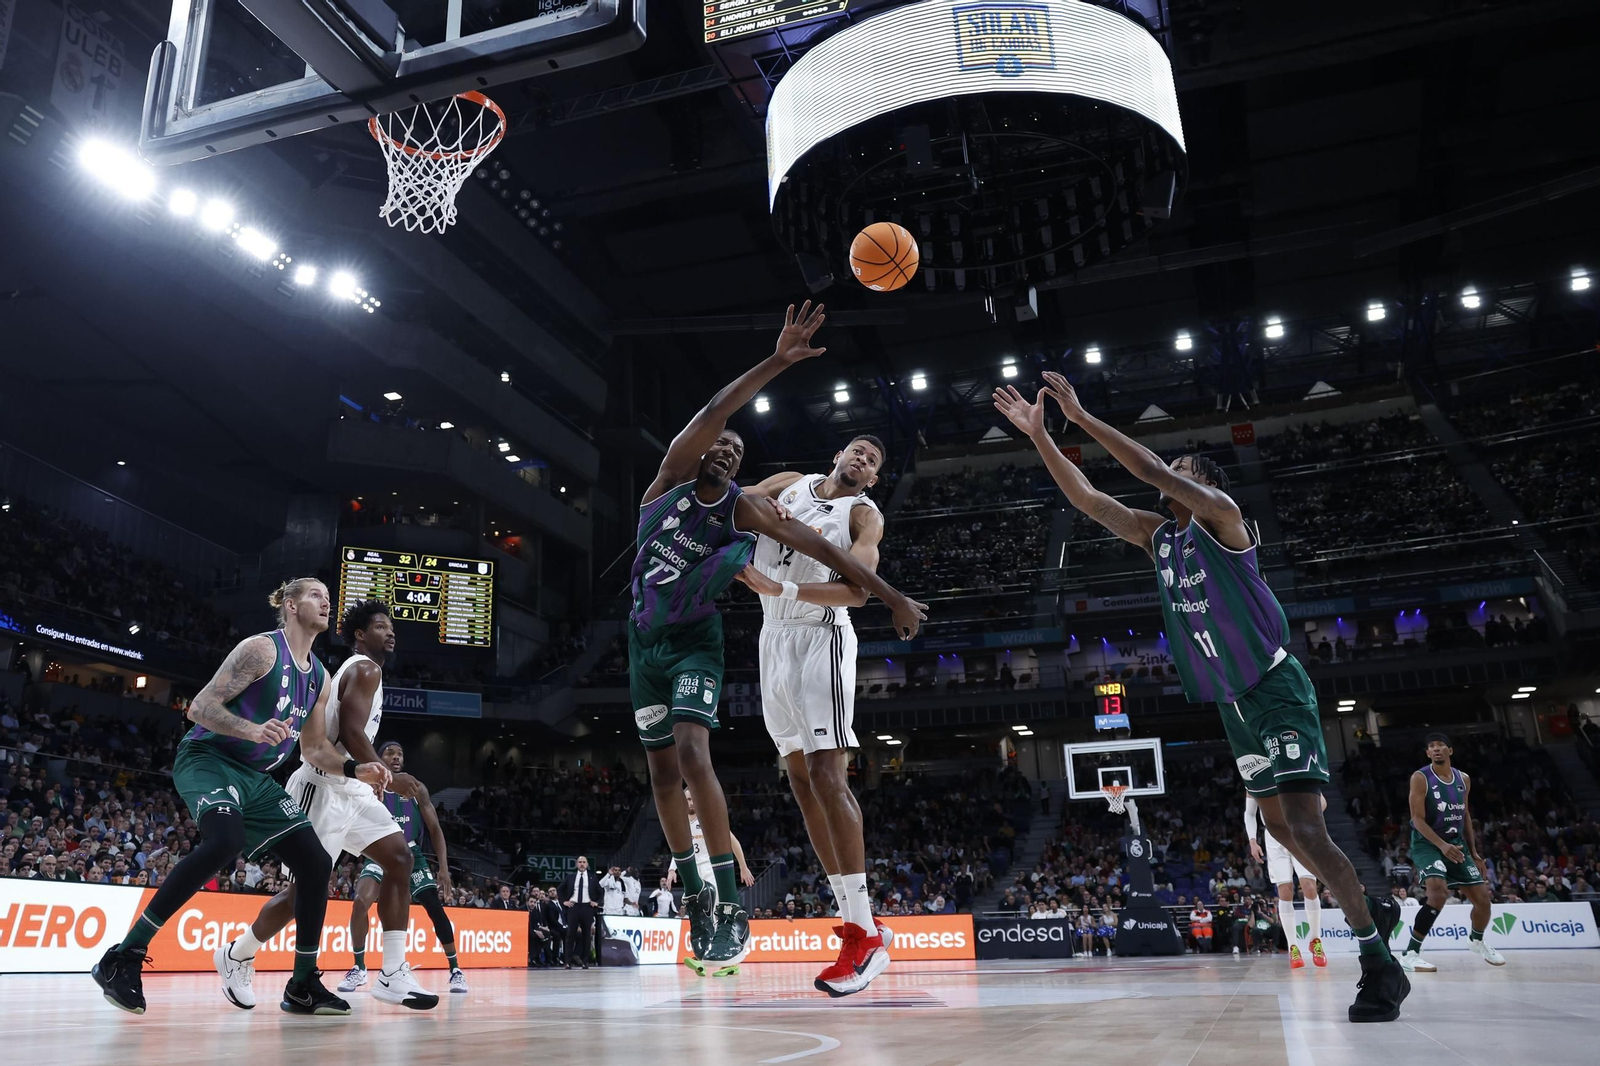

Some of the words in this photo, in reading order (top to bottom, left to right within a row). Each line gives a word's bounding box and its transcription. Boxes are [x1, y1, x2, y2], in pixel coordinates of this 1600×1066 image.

[720, 10, 752, 23] ANDRES
[753, 5, 775, 15] FELIZ
[720, 28, 733, 37] ELI
[734, 22, 756, 34] JOHN
[757, 15, 787, 28] NDIAYE
[65, 21, 121, 78] ULEB
[673, 530, 713, 557] Unicaja
[399, 555, 411, 564] 32
[425, 558, 437, 567] 24
[415, 574, 421, 582] 2
[645, 557, 680, 585] 77
[406, 591, 431, 604] 4:04
[422, 611, 429, 619] 2
[36, 624, 64, 639] Consigue
[65, 632, 75, 642] tus
[75, 635, 100, 649] entradas
[101, 642, 109, 652] en
[1194, 630, 1219, 658] 11
[1104, 696, 1121, 715] 13
[527, 857, 590, 870] SALID
[978, 923, 1064, 942] endesa
[1137, 922, 1168, 931] Unicaja
[1522, 919, 1585, 941] Unicaja
[459, 929, 512, 953] meses
[893, 931, 966, 949] meses
